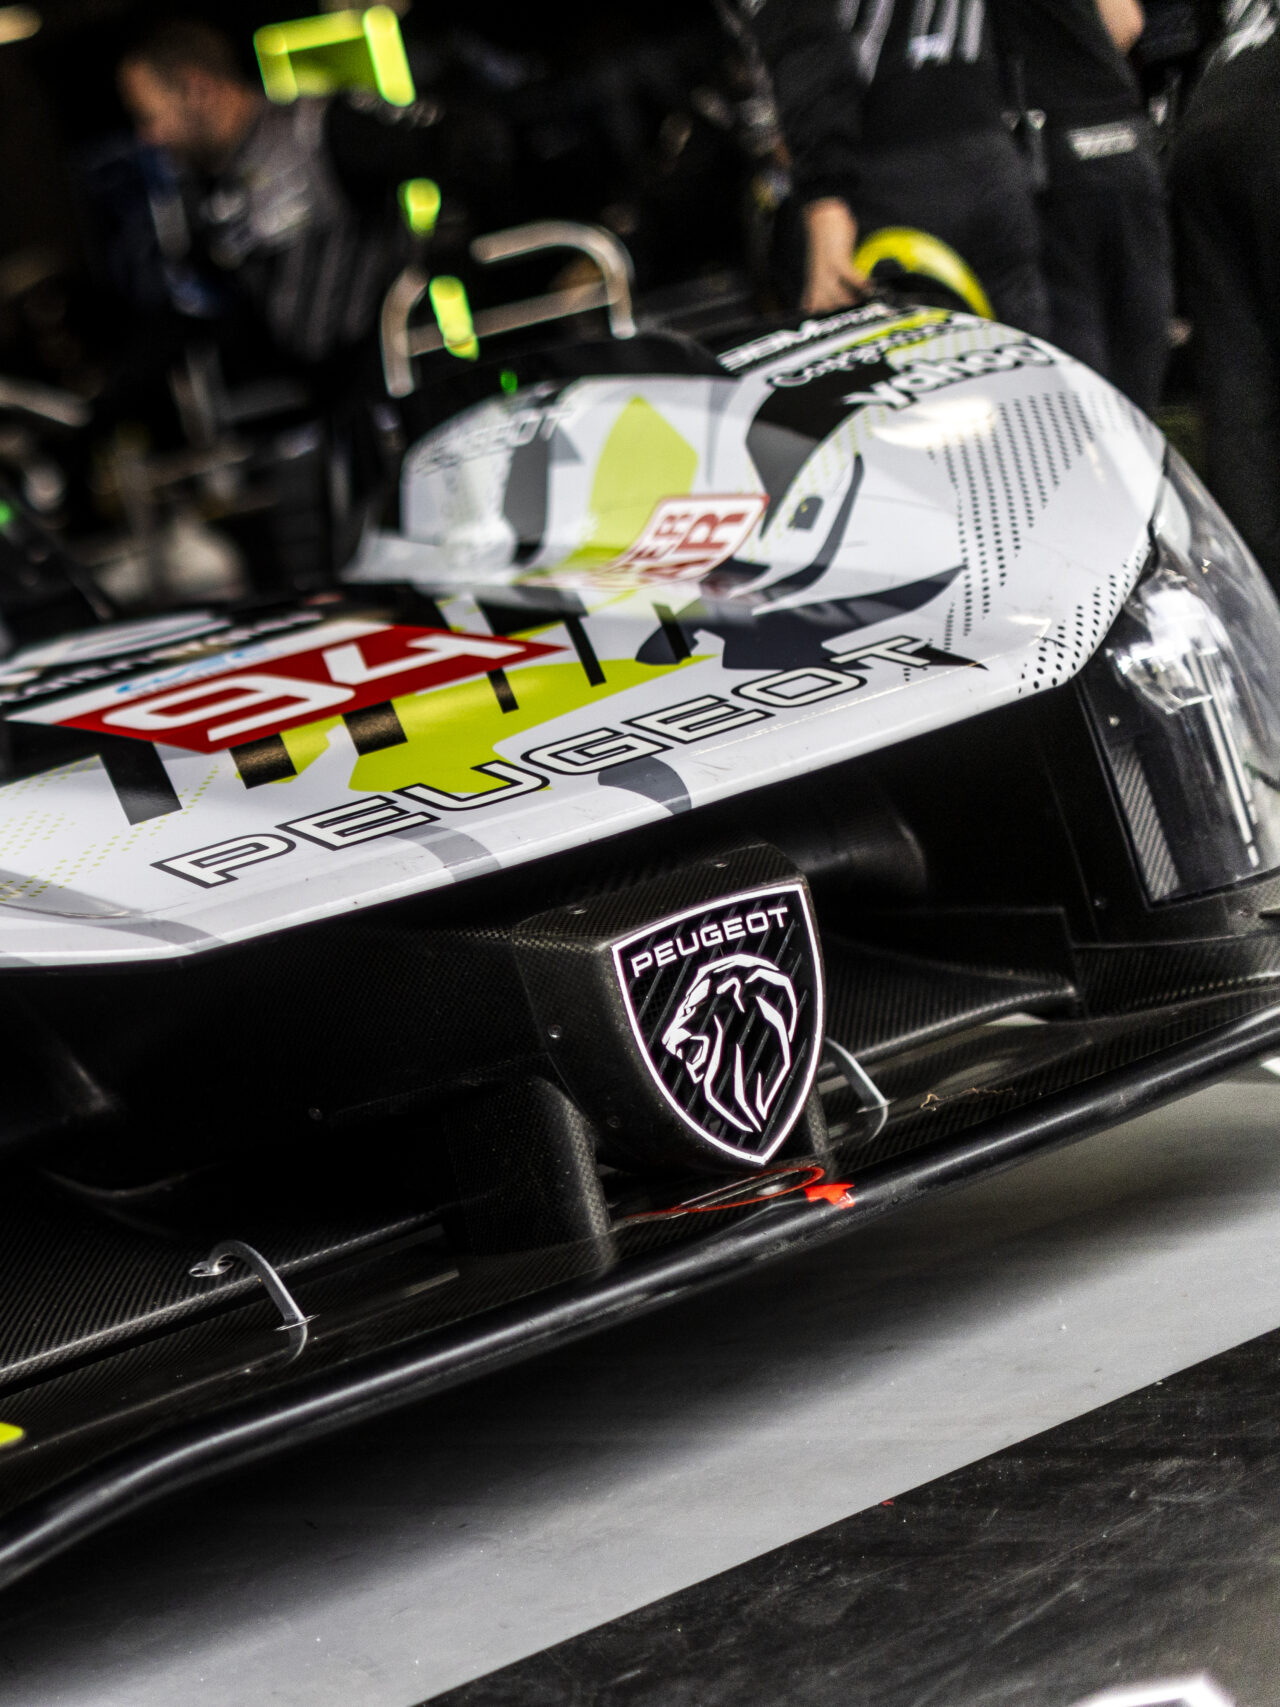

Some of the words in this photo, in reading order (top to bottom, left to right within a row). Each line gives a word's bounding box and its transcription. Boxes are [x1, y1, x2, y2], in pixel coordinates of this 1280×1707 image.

[101, 633, 527, 742] 94
[151, 635, 933, 889] PEUGEOT
[630, 906, 789, 978] PEUGEOT
